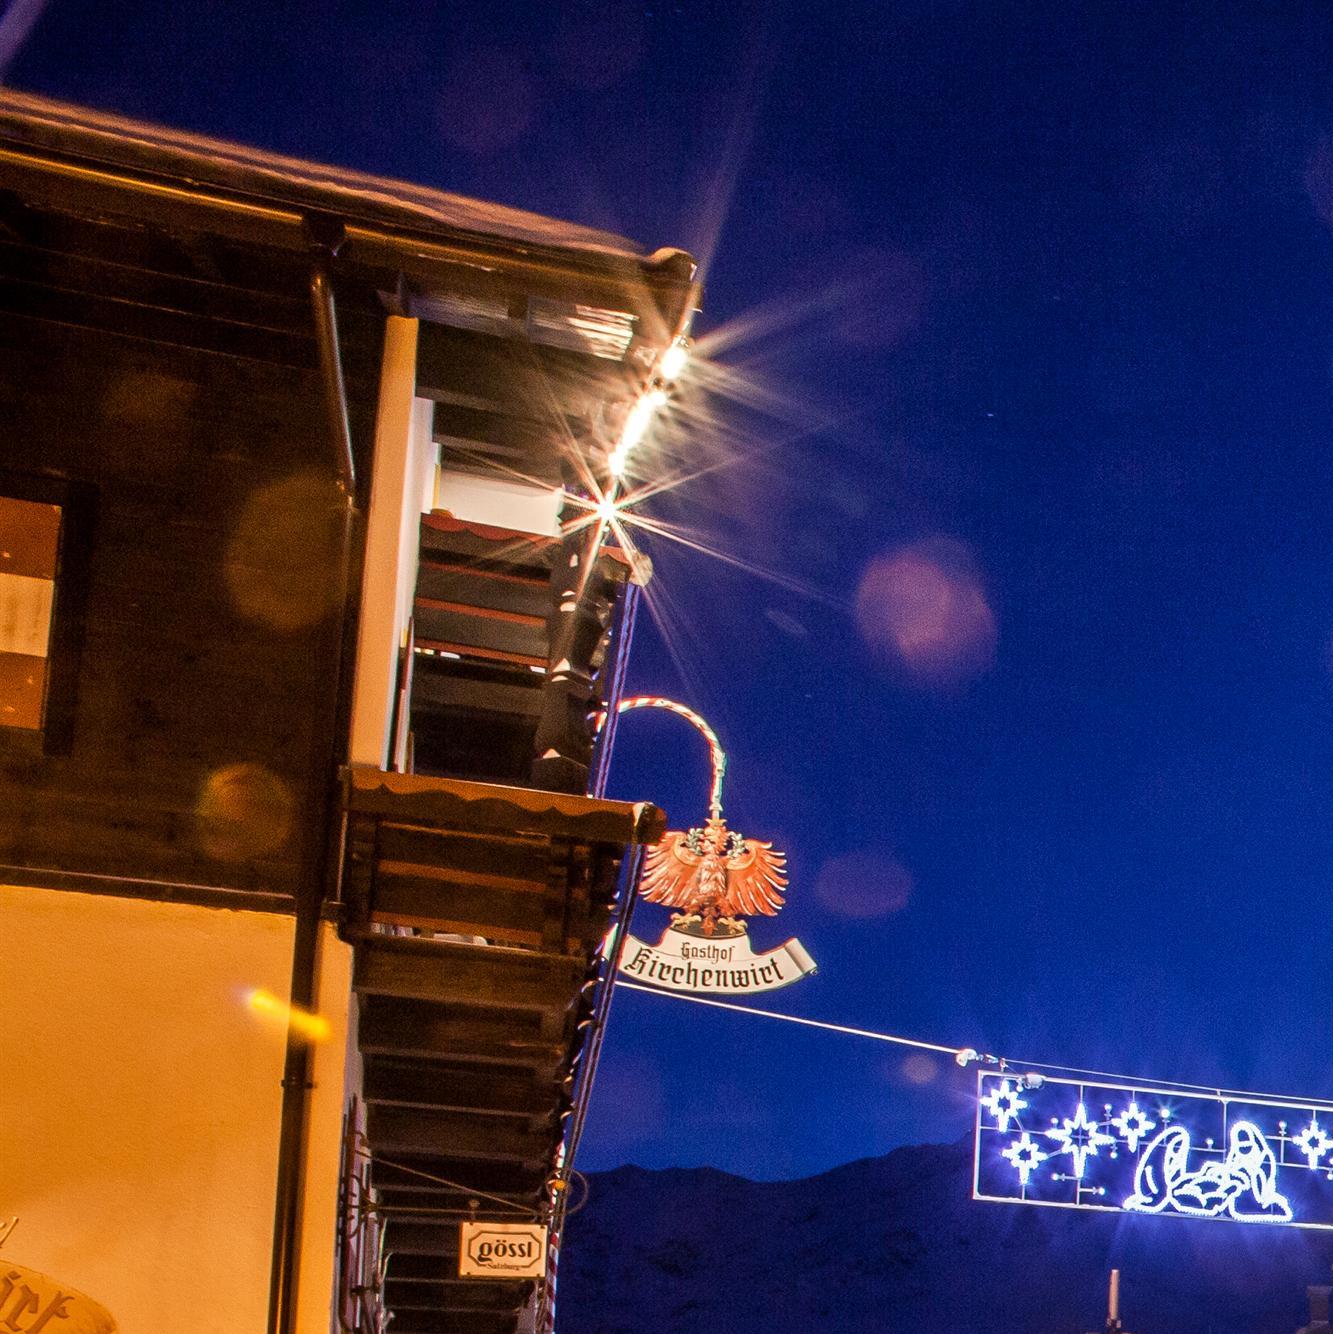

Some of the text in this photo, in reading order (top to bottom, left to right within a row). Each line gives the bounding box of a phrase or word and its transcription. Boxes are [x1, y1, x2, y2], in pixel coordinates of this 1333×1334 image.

[681, 942, 735, 963] Gasthof
[624, 947, 784, 988] Kirchenwirt
[477, 1240, 532, 1262] gössl
